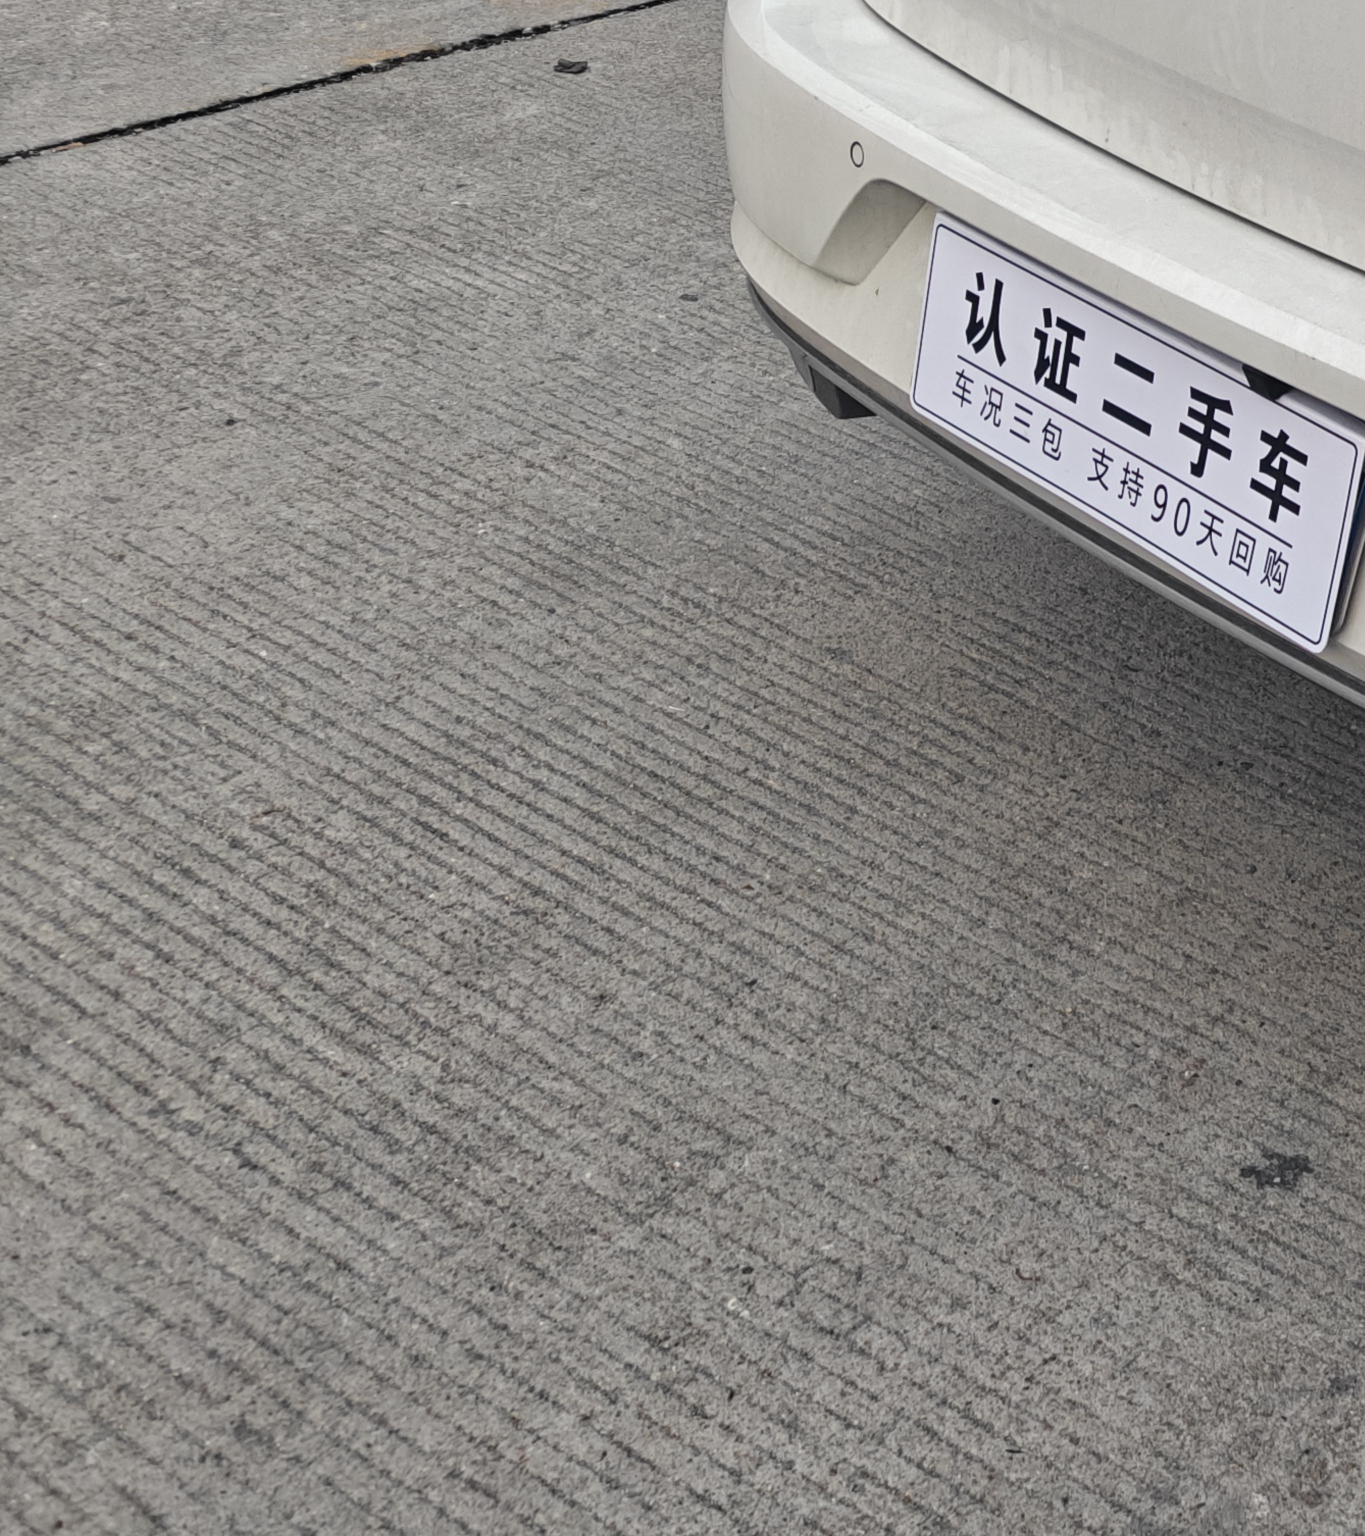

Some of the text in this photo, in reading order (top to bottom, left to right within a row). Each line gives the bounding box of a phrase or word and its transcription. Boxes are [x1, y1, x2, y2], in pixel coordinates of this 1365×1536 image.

[951, 368, 1290, 595] 车况三包 支持90天回购
[964, 271, 1309, 524] 认证二手车
